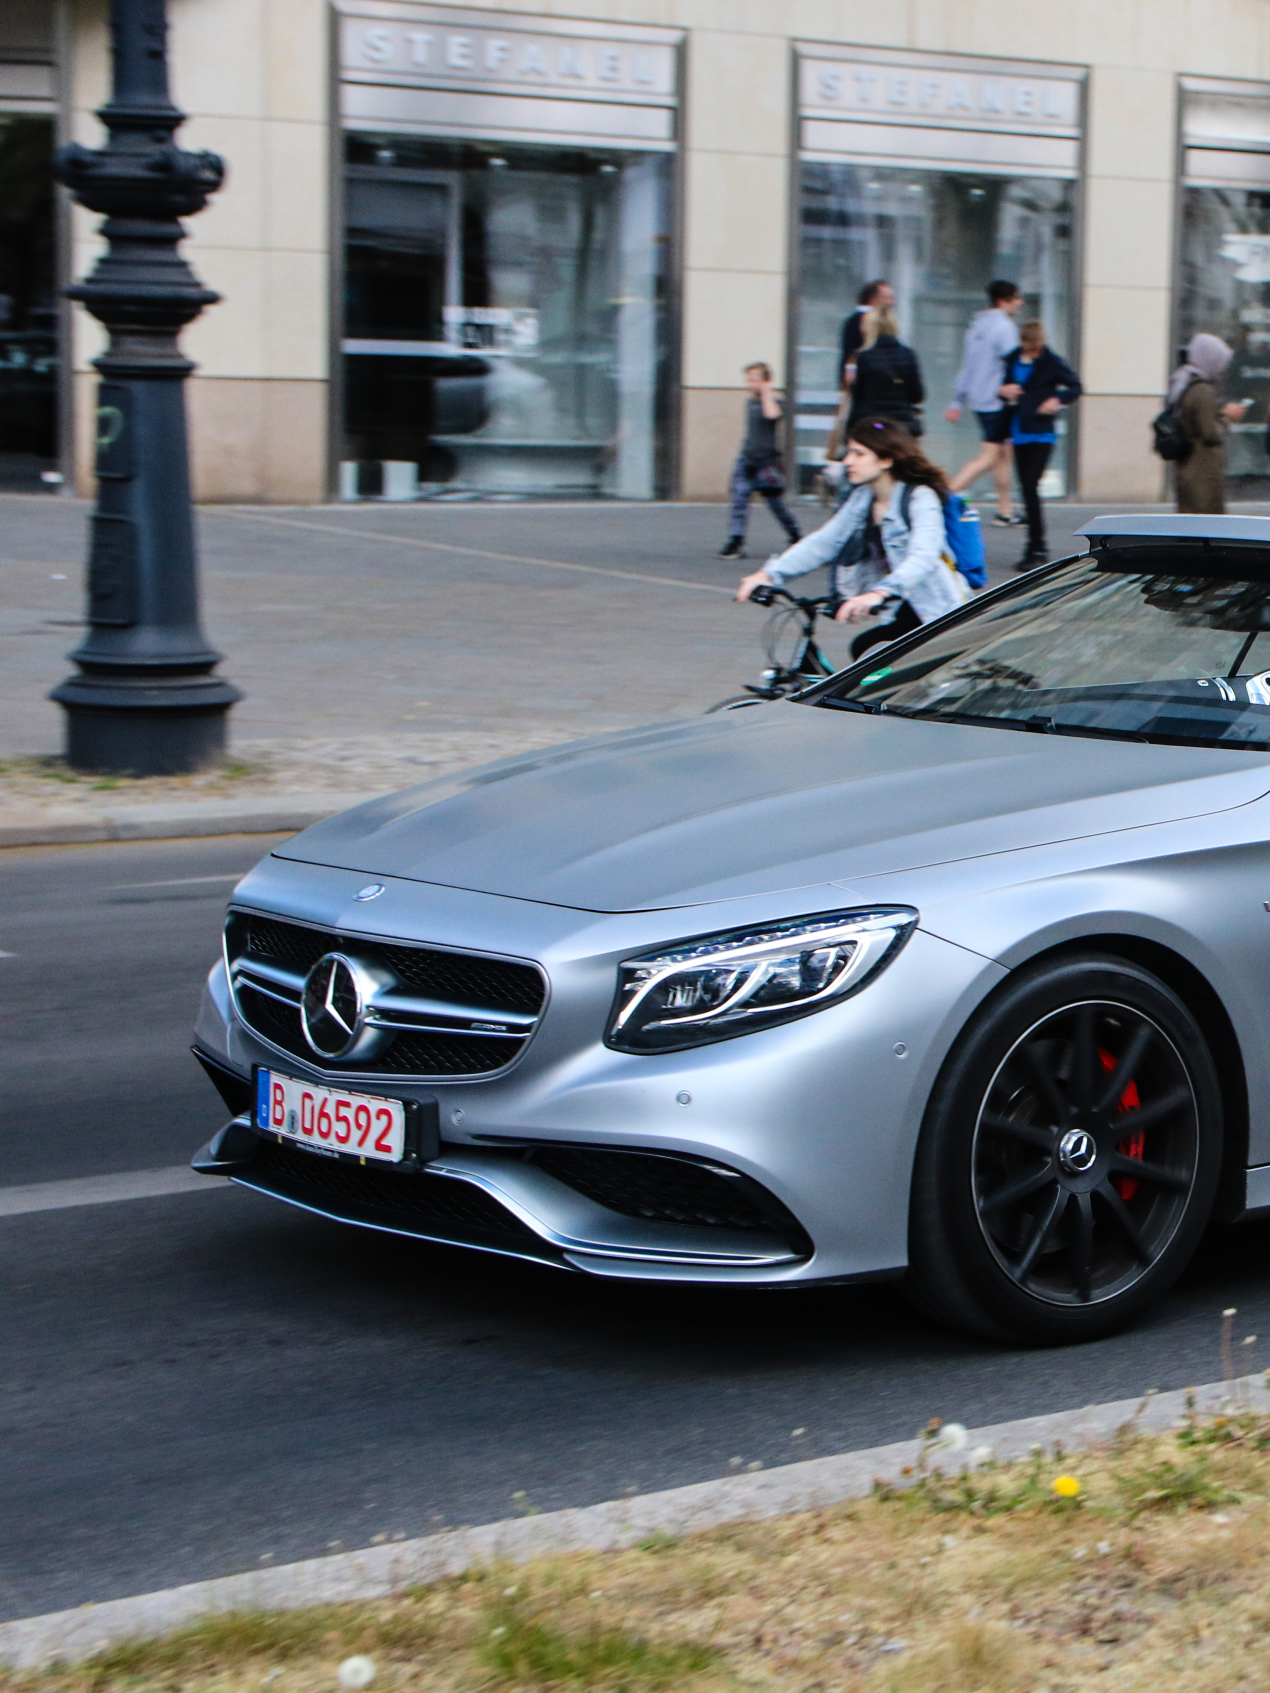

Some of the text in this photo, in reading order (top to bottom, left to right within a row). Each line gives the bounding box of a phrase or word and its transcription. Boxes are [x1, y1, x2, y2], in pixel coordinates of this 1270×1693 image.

[361, 27, 656, 85] STEFANEL
[816, 69, 1062, 118] STEFANEL
[272, 1081, 393, 1153] B 06592
